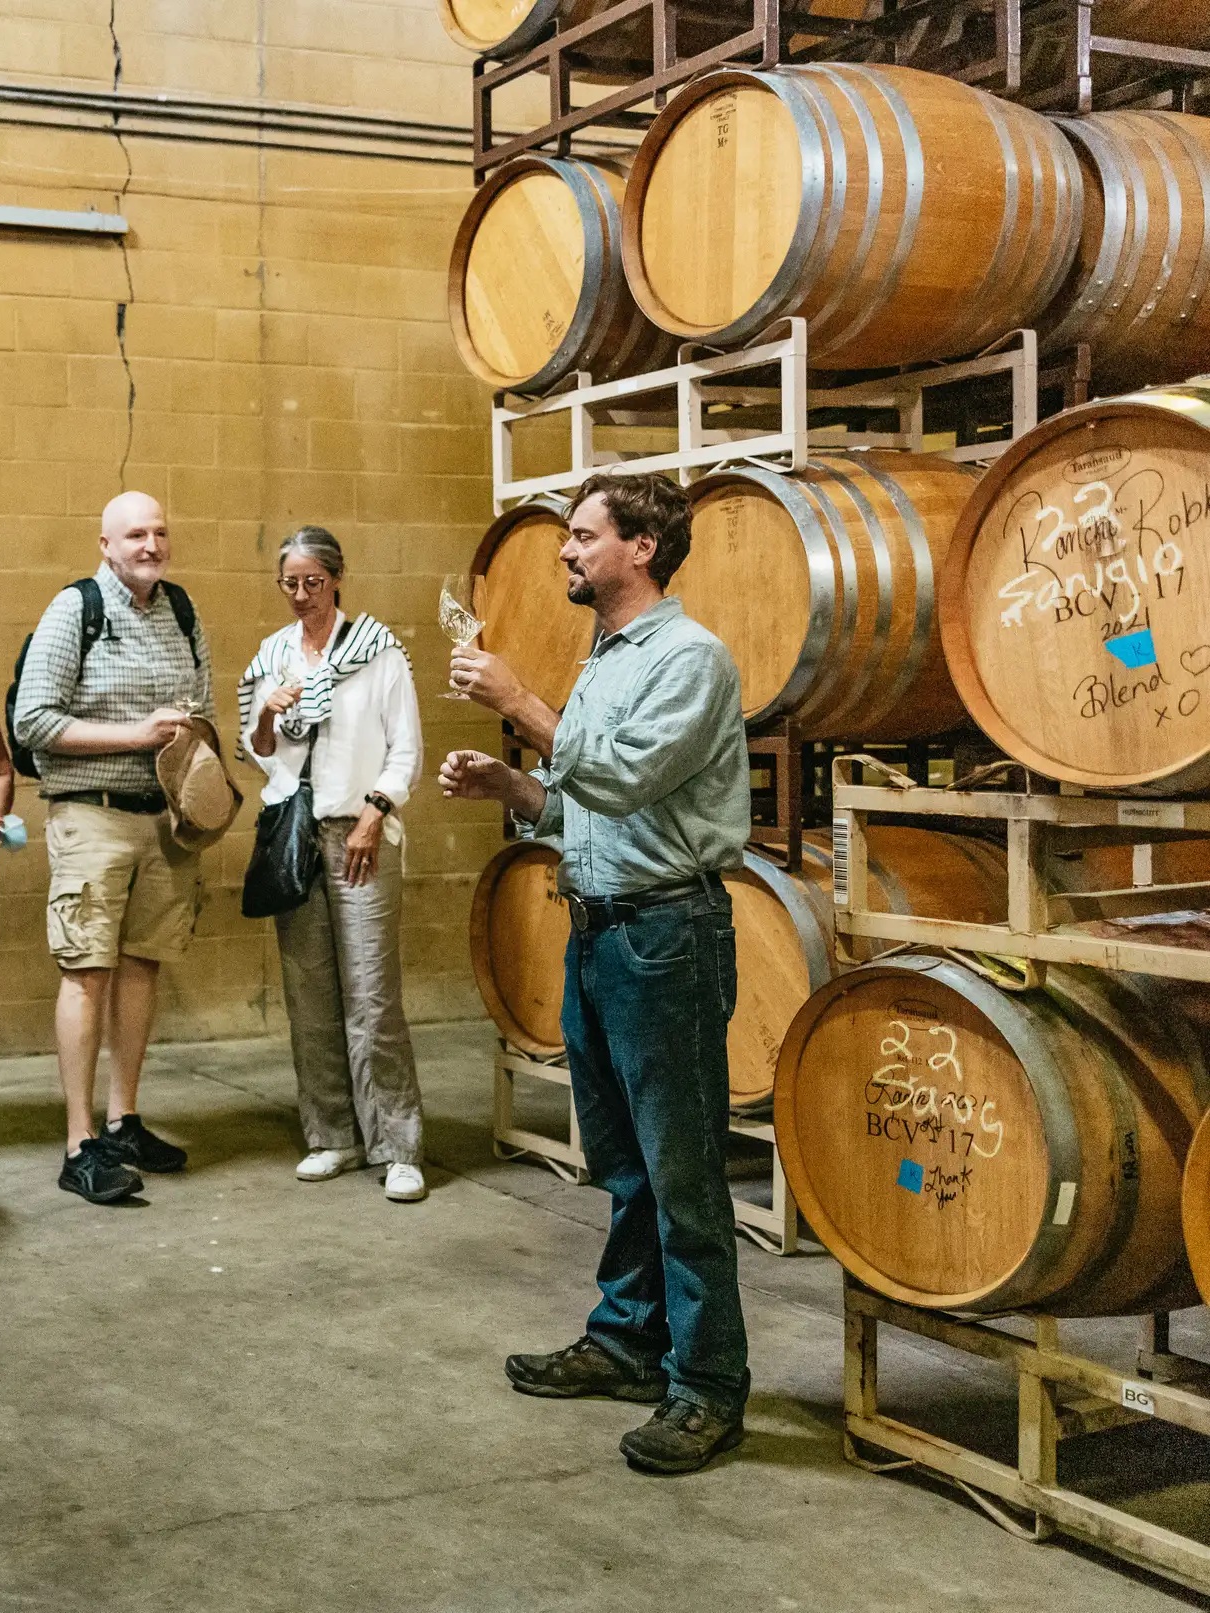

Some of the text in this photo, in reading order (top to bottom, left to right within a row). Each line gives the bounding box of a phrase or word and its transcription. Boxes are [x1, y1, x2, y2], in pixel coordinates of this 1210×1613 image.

[1055, 566, 1184, 625] BCV 17
[1073, 662, 1171, 719] Blend
[880, 1020, 963, 1082] 22
[866, 1111, 918, 1145] BCV
[949, 1128, 975, 1157] 17
[924, 1165, 973, 1192] Thank
[1125, 1388, 1149, 1406] BG
